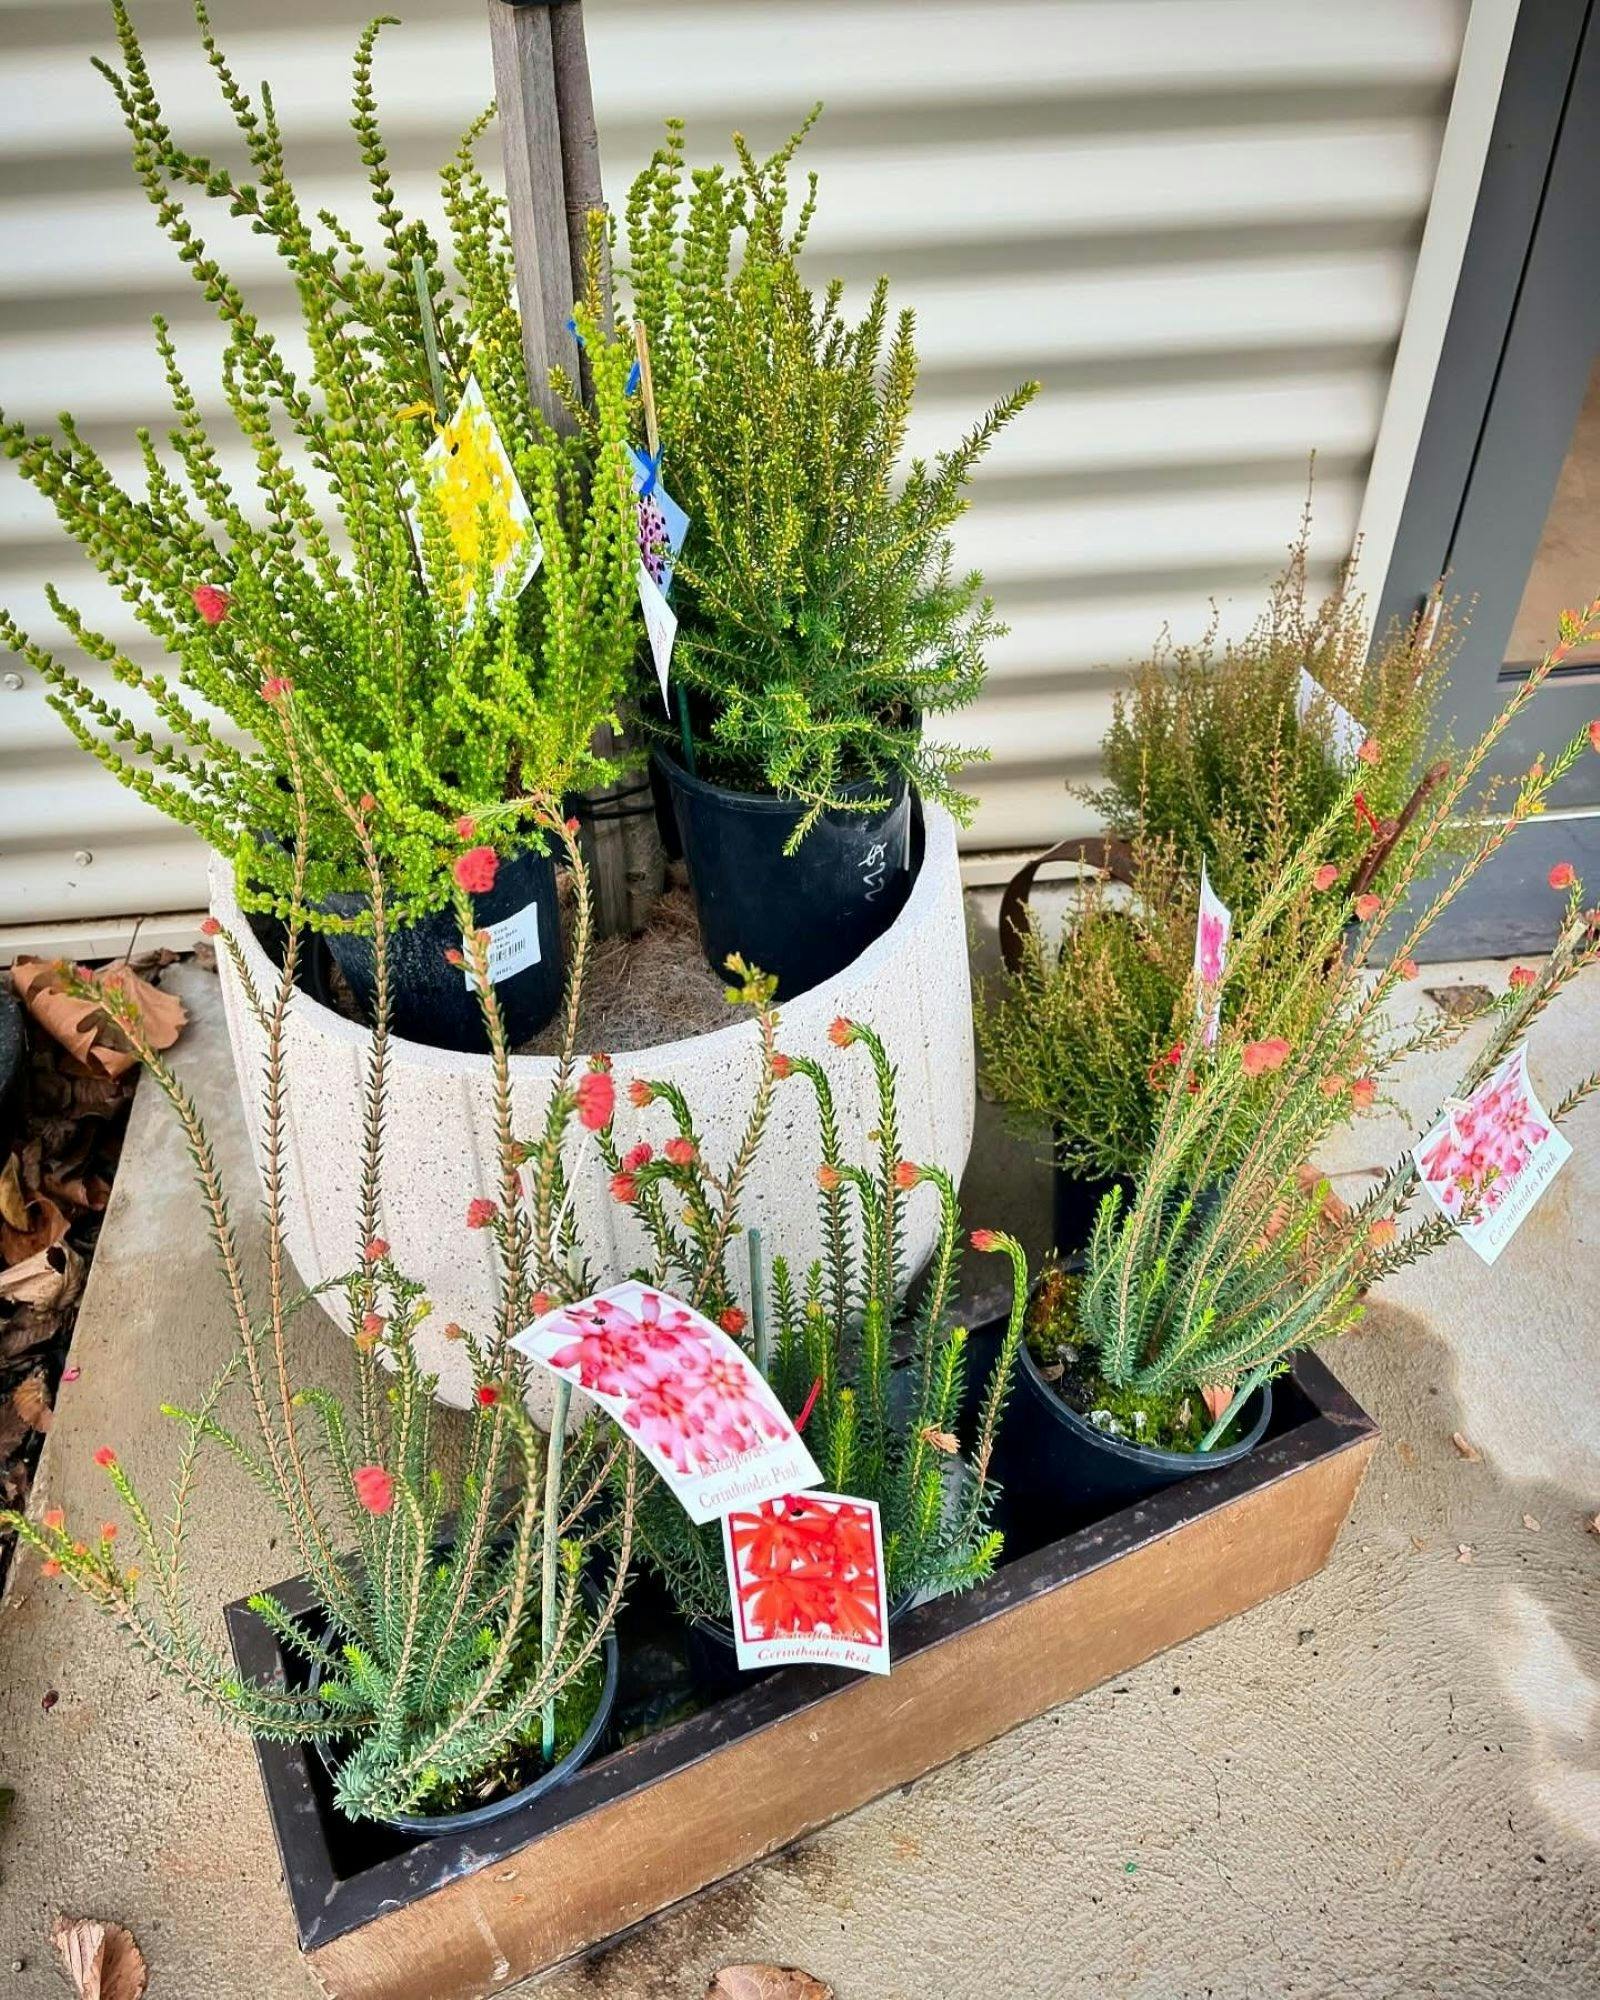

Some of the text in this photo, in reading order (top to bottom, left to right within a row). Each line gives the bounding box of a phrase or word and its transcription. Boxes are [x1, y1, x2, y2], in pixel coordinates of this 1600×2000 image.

[1489, 1152, 1559, 1246] Cerinthoides Pink
[699, 1459, 802, 1509] Cerinthoides Pink
[757, 1645, 872, 1665] Cerinthoides Red
